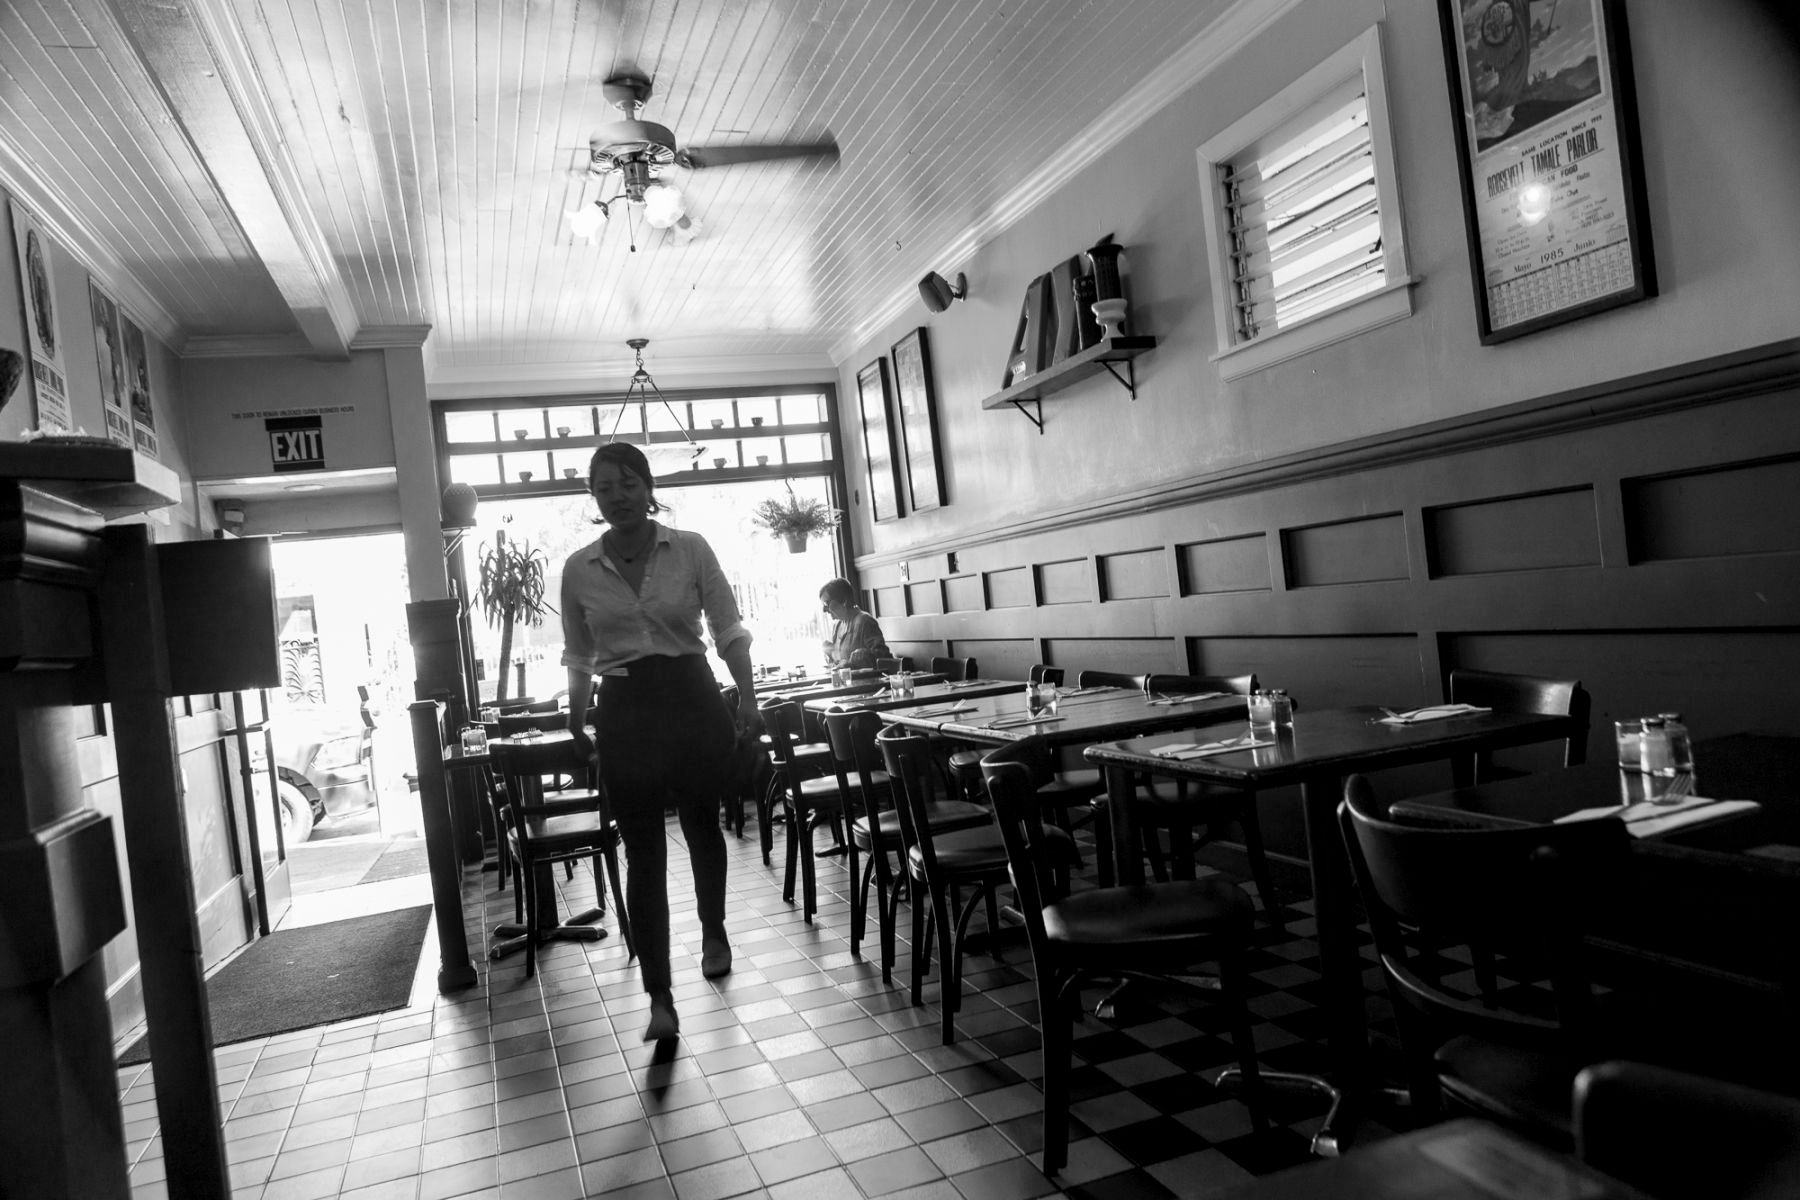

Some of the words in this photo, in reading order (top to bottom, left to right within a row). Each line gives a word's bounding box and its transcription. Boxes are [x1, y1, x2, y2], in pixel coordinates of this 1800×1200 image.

[1539, 130, 1568, 148] LOCATION
[1571, 120, 1587, 132] SINCE
[1486, 161, 1525, 199] ROOSEVELT
[1530, 144, 1562, 178] TAMALE
[1566, 127, 1598, 162] PARLOR
[1560, 164, 1578, 177] FOOD
[1514, 263, 1532, 274] Mayo
[1540, 247, 1564, 264] 1985
[1573, 239, 1596, 253] Junio
[271, 430, 320, 462] EXIT
